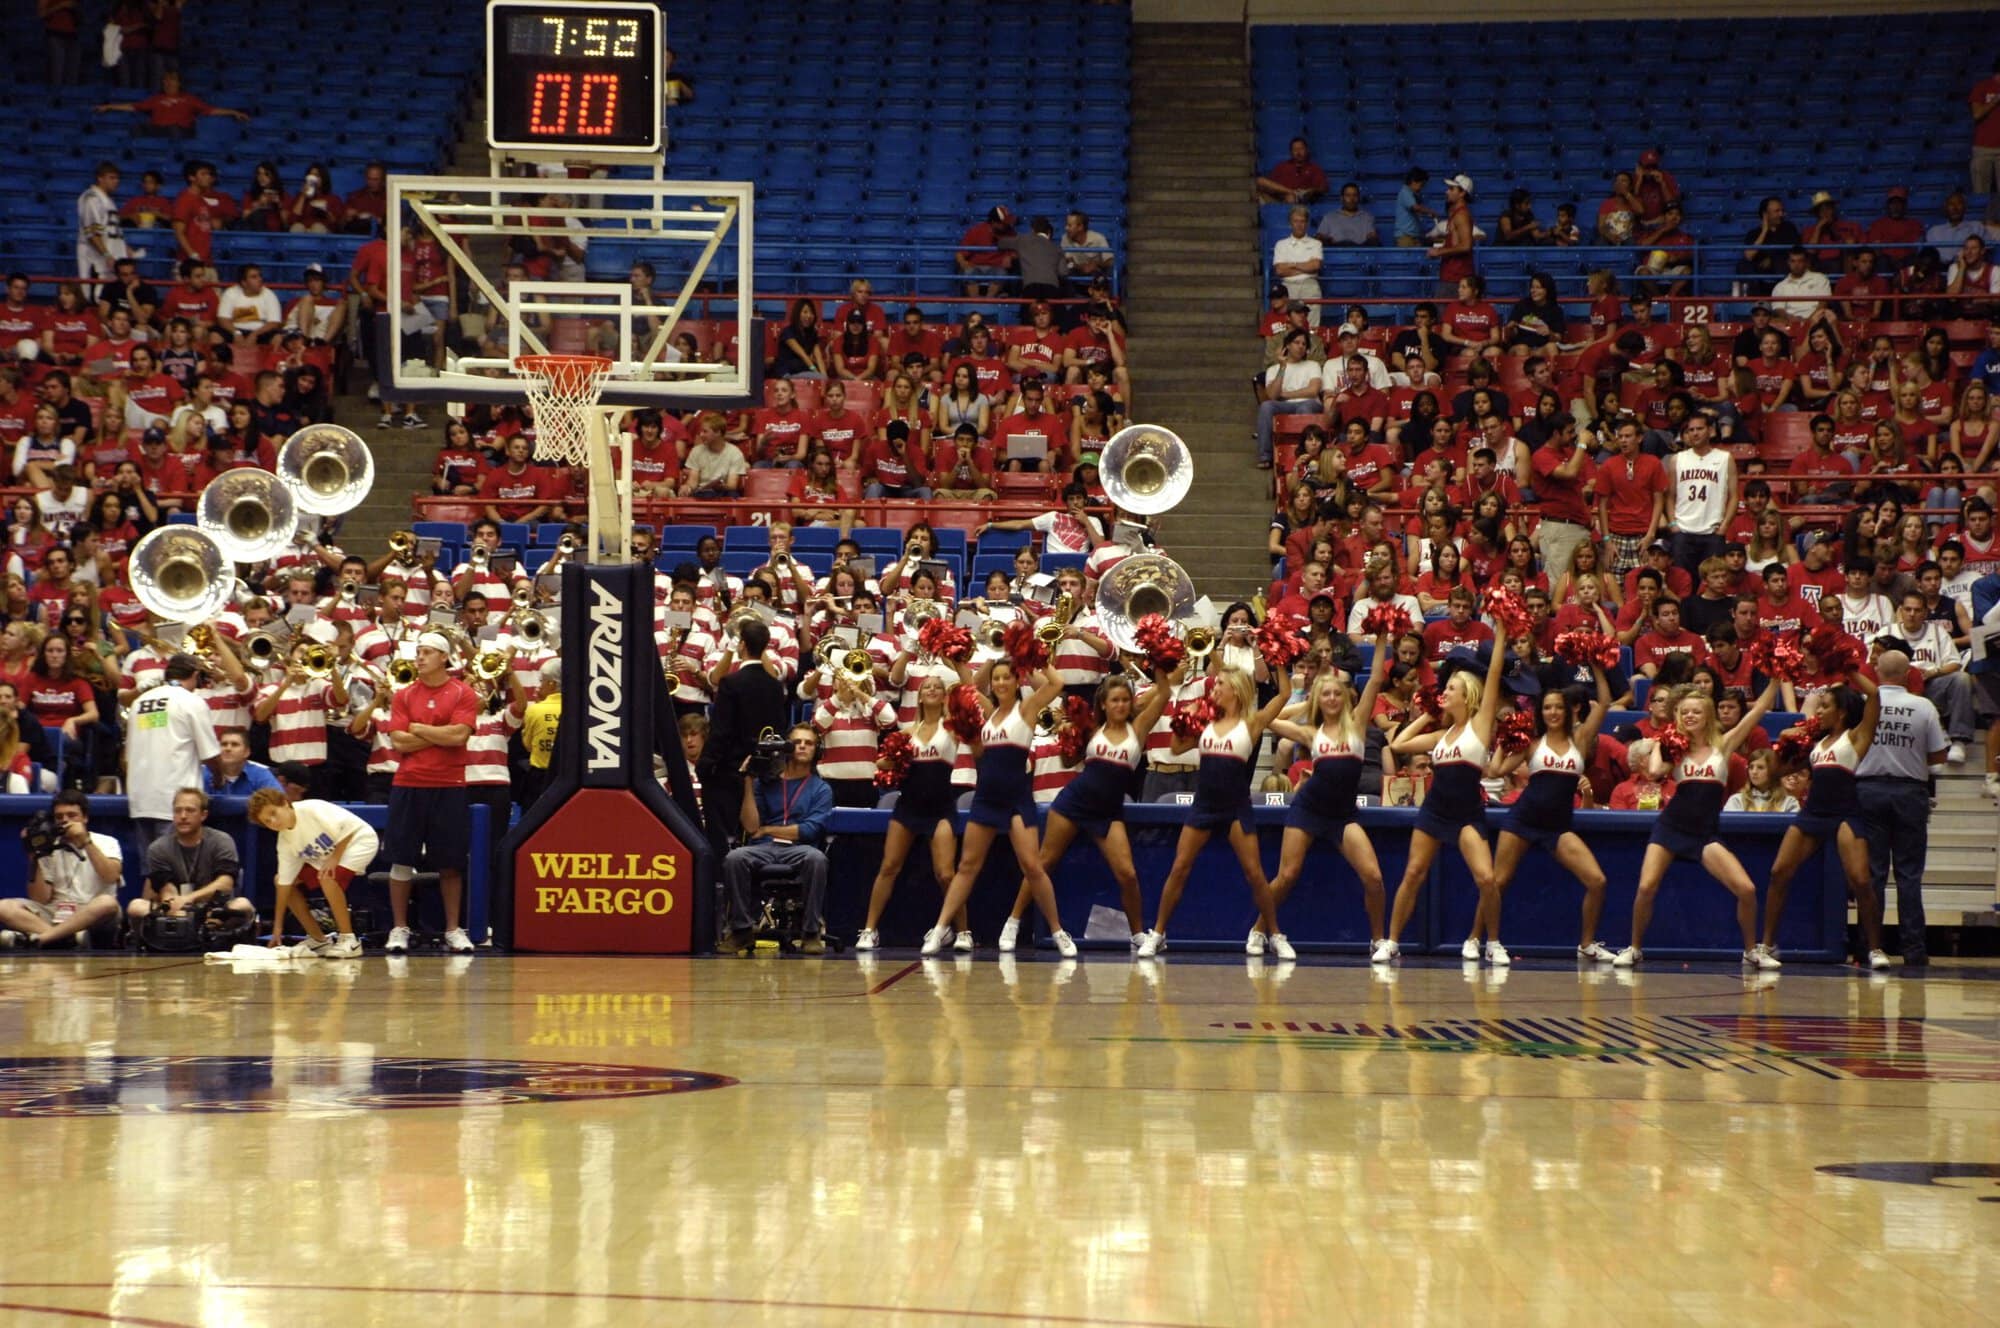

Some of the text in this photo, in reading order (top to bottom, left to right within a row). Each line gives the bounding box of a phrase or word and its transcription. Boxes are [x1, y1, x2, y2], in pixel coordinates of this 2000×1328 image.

[543, 18, 638, 57] 7:52
[531, 74, 618, 135] 00
[1683, 305, 1708, 323] 22
[1680, 469, 1718, 483] ARIZONA
[1688, 485, 1707, 502] 34
[751, 512, 771, 528] 21
[1847, 619, 1880, 634] IZONA
[588, 579, 622, 768] ARIZONA
[1878, 720, 1912, 732] TAFF
[1873, 732, 1915, 748] CURITY
[531, 853, 677, 881] WELLS
[535, 888, 674, 915] FARGO
